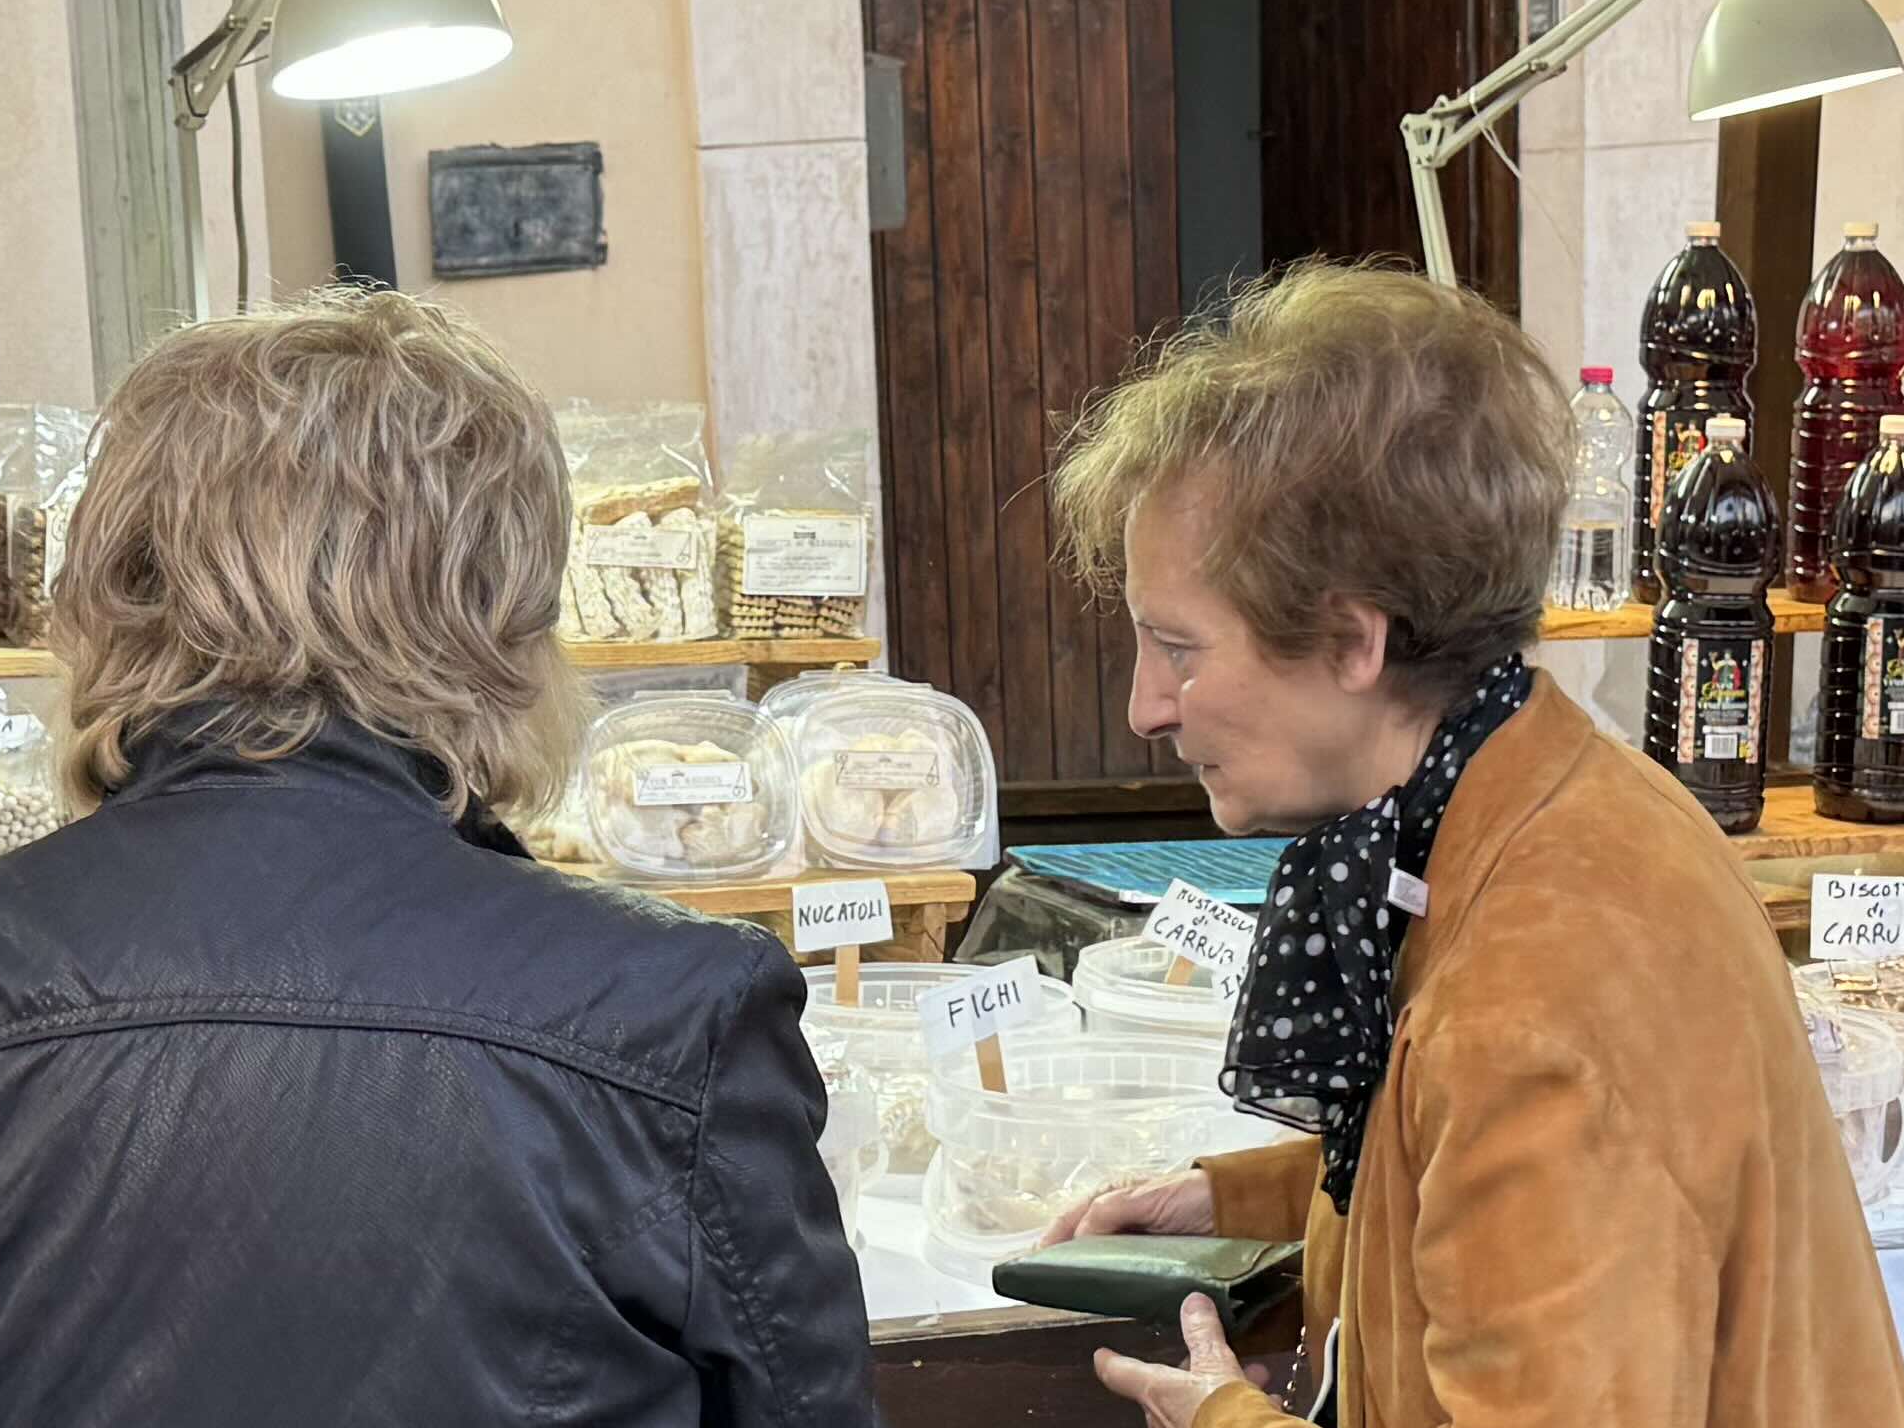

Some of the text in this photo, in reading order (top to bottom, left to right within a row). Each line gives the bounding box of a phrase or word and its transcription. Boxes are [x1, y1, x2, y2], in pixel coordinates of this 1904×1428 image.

[798, 899, 883, 928] NUCATOLI
[1866, 902, 1884, 918] di
[947, 980, 1022, 1029] FICHI
